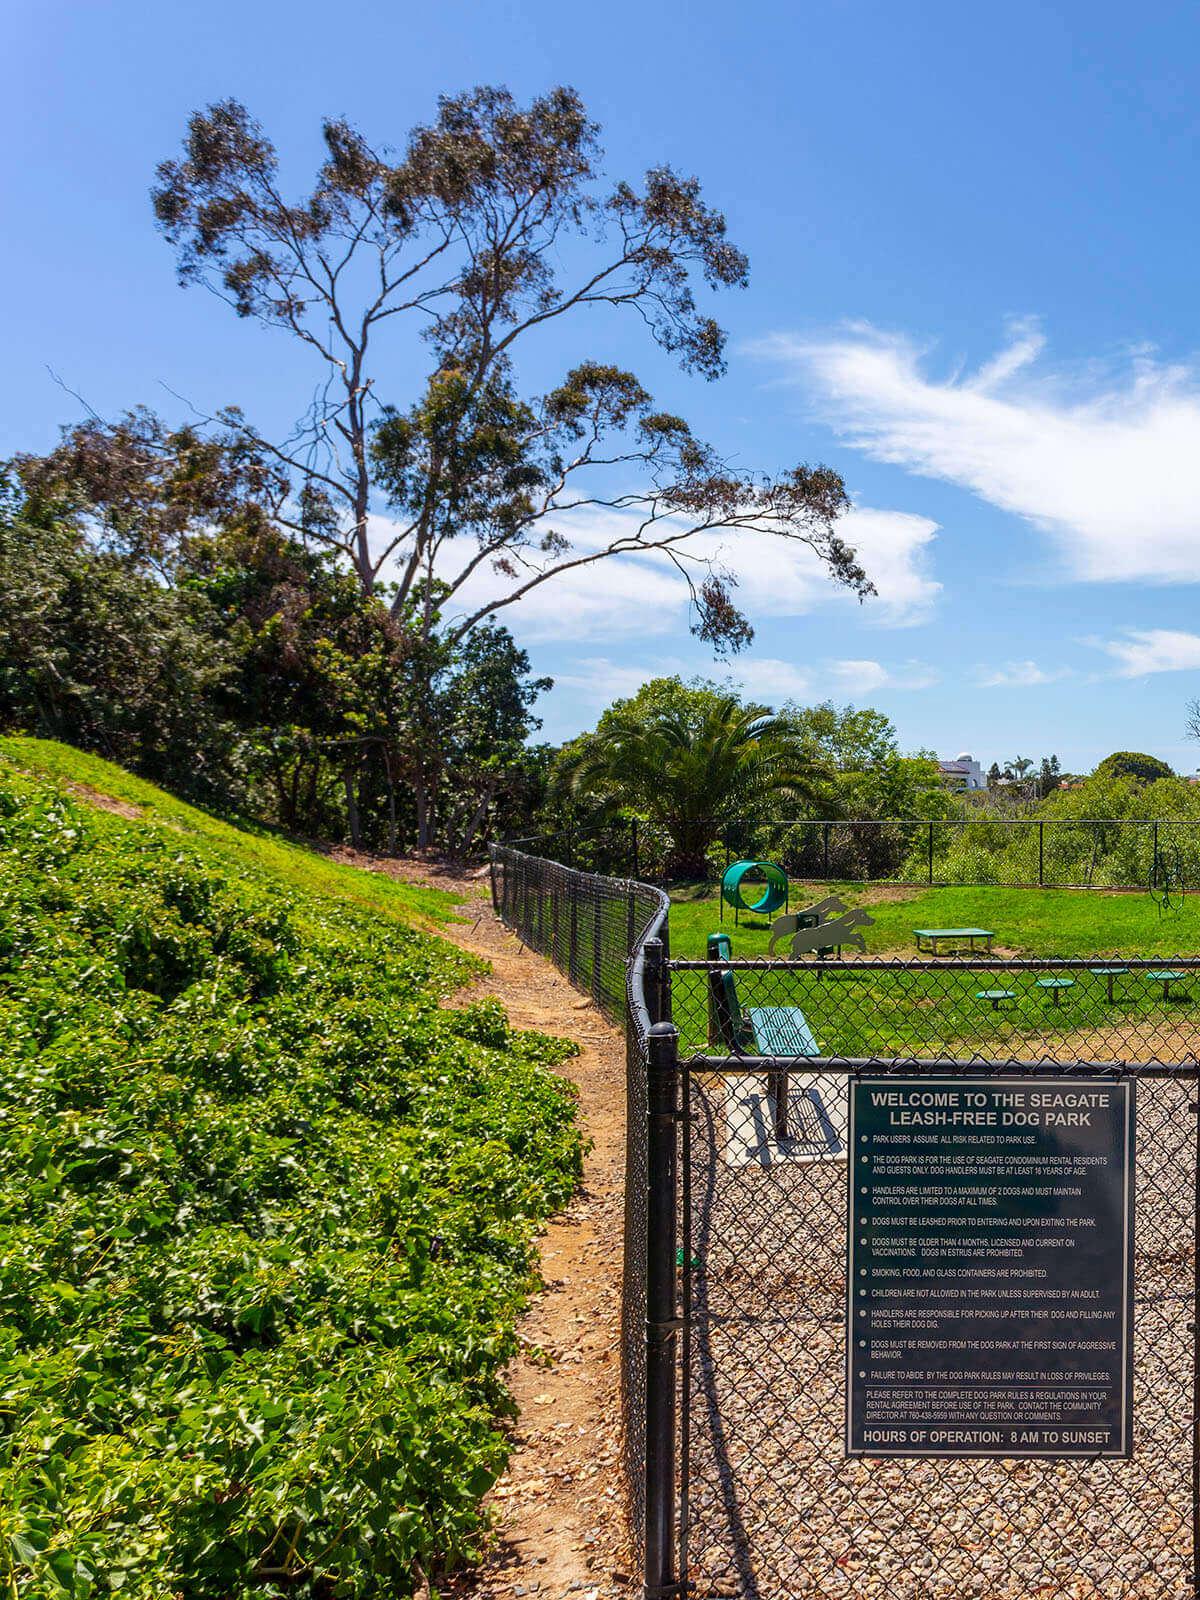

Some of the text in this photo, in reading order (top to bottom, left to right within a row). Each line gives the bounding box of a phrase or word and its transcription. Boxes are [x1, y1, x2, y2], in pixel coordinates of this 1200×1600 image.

[871, 1093, 1109, 1108] WELCOME TO THE SEAGATE
[890, 1112, 1091, 1126] LEASH-FREE DOG PARK
[873, 1135, 890, 1143] PARK
[891, 1135, 911, 1143] USERS
[913, 1135, 938, 1143] ASSUME
[941, 1135, 952, 1143] ALL
[953, 1135, 967, 1143] RISK
[968, 1135, 995, 1143] RELATED
[1006, 1136, 1022, 1144] PARK
[886, 1156, 1108, 1165] DOG PARK FOR USE SEAGATE CONDOMINIUM RENTAL RESIDENTS
[887, 1166, 911, 1174] GUESTS
[931, 1166, 944, 1175] DOG
[945, 1166, 978, 1175] HANDLERS
[979, 1167, 996, 1175] MUST
[1015, 1167, 1033, 1175] LEAST
[1043, 1167, 1063, 1175] YEARS
[872, 1187, 1081, 1195] HANDLERS LIMITED MAXIMUM DOGS MUST MAINTAIN
[872, 1197, 902, 1205] CONTROL
[902, 1197, 920, 1205] OVER
[921, 1197, 939, 1205] THEIR
[940, 1197, 957, 1205] DOGS
[967, 1197, 977, 1205] ALL
[872, 1217, 890, 1225] DOGS
[947, 1218, 966, 1226] PRIOR
[977, 1218, 1008, 1226] ENTERING
[1023, 1218, 1040, 1226] UPON
[1041, 1218, 1065, 1226] EXITING
[872, 1238, 890, 1246] DOGS
[891, 1238, 908, 1246] MUST
[919, 1238, 939, 1246] OLDER
[940, 1238, 956, 1246] THAN
[1035, 1239, 1064, 1247] CURRENT
[922, 1248, 939, 1256] DOGS
[936, 1269, 956, 1277] GLASS
[957, 1269, 996, 1277] CONTAINERS
[871, 1289, 902, 1297] CHILDREN
[918, 1289, 929, 1297] NOT
[930, 1289, 959, 1297] ALLOWED
[981, 1290, 997, 1298] PARK
[998, 1290, 1022, 1298] UNLESS
[1023, 1290, 1061, 1298] SUPERVISED
[871, 1310, 905, 1318] HANDLERS
[918, 1310, 960, 1318] RESPONSIBLE
[961, 1310, 974, 1318] FOR
[975, 1310, 999, 1318] PICKING
[1010, 1310, 1030, 1318] AFTER
[1031, 1310, 1049, 1318] THEIR
[871, 1320, 893, 1328] HOLES
[893, 1320, 911, 1328] THEIR
[912, 1320, 926, 1328] DOG
[890, 1341, 907, 1349] MUST
[917, 1341, 947, 1349] REMOVED
[948, 1341, 966, 1349] FROM
[981, 1341, 994, 1349] DOG
[995, 1341, 1012, 1349] PARK
[1034, 1341, 1051, 1349] FIRST
[1051, 1341, 1067, 1349] SIGN
[1078, 1341, 1116, 1349] AGGRESSIVE
[871, 1371, 896, 1379] FAILURE
[906, 1371, 924, 1379] ABIDE
[949, 1371, 963, 1379] DOG
[982, 1372, 1001, 1380] RULES
[1002, 1372, 1015, 1380] MAY
[1016, 1372, 1039, 1380] RESULT
[1048, 1372, 1063, 1380] LOSS
[892, 1391, 913, 1399] REFER
[938, 1391, 974, 1399] COMPLETE
[975, 1391, 988, 1399] DOG
[990, 1391, 1007, 1399] PARK
[1008, 1391, 1028, 1399] RULES
[1035, 1392, 1080, 1400] REGULATIONS
[1088, 1392, 1106, 1400] YOUR
[867, 1401, 891, 1409] RENTAL
[892, 1401, 930, 1409] AGREEMENT
[932, 1401, 958, 1409] BEFORE
[959, 1401, 971, 1409] USE
[1063, 1402, 1101, 1410] COMMUNITY
[980, 1412, 1012, 1420] QUESTION
[864, 1431, 1110, 1443] HOURS OF OPERATION: 8 AM TO SUNSET
